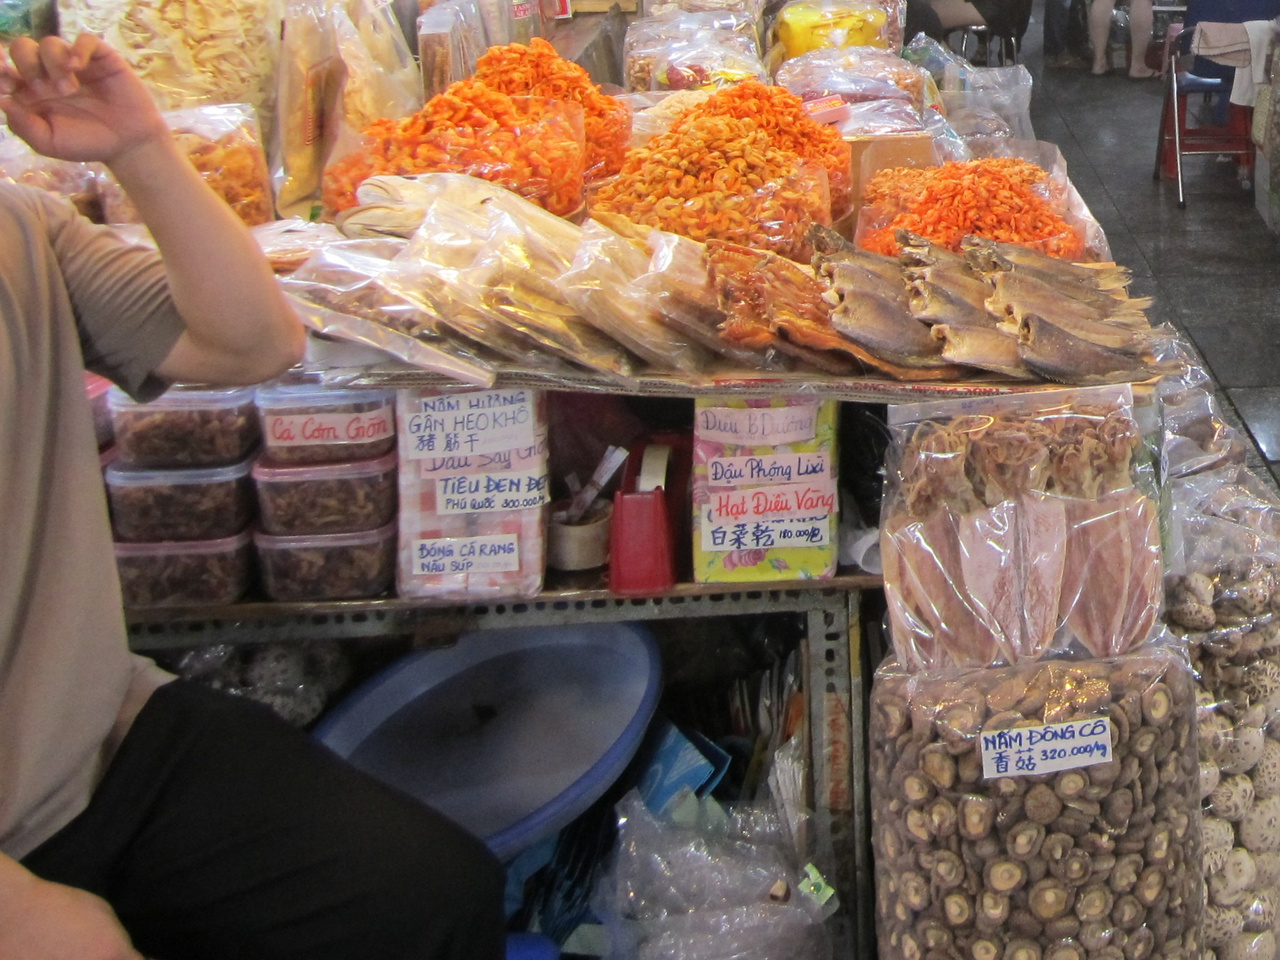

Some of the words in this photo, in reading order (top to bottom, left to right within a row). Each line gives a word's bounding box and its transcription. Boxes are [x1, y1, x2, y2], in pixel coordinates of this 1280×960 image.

[408, 414, 445, 434] GÂN
[453, 412, 489, 432] HEO
[492, 406, 530, 429] KHÔ
[711, 460, 745, 485] Đậu
[715, 493, 748, 521] Hạt
[459, 541, 476, 557] CÁ
[478, 542, 516, 557] RANG
[983, 727, 1023, 751] NẤM
[1026, 724, 1076, 746] ĐÔNG
[1078, 719, 1108, 738] CÔ
[991, 746, 1038, 774] 香菇
[1040, 741, 1108, 761] 320.000/kg
